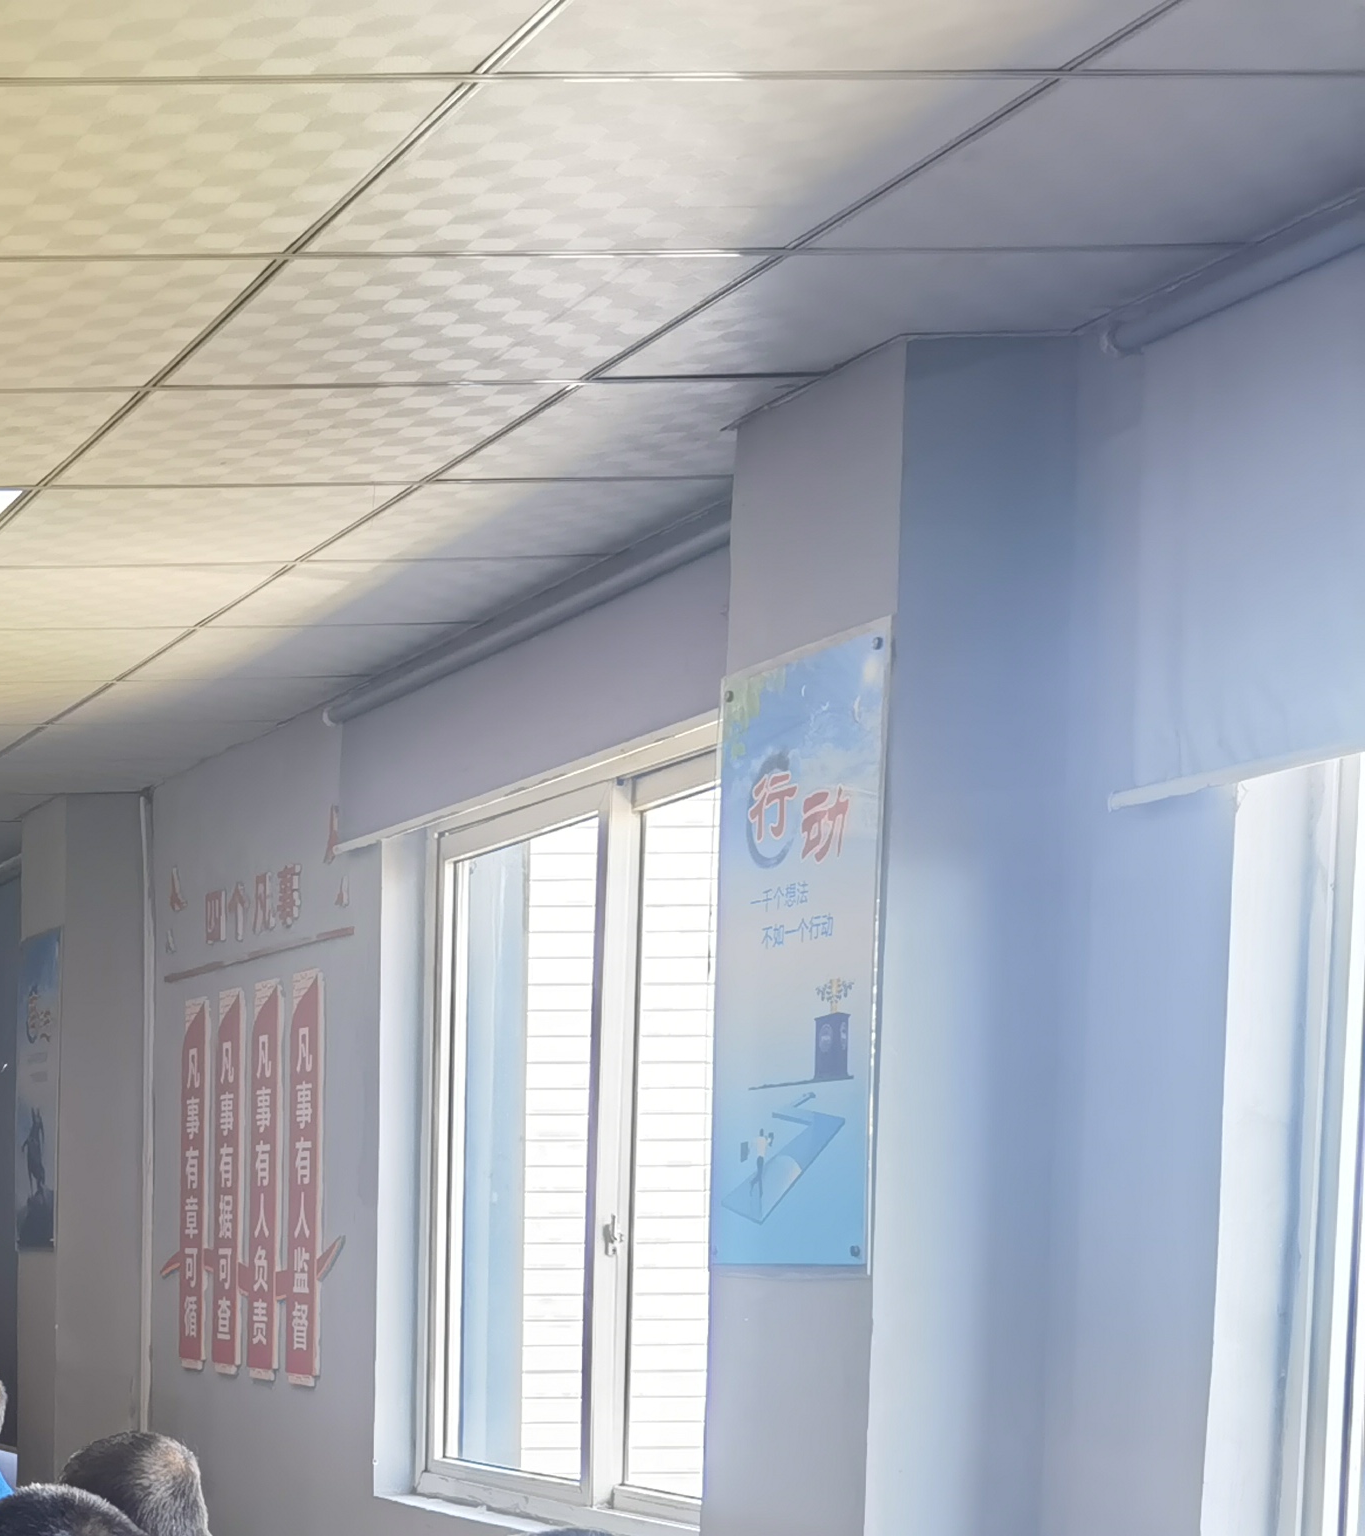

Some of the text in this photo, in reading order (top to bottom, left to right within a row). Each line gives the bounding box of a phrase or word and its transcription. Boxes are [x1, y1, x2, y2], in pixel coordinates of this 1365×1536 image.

[748, 772, 850, 864] 行动
[750, 881, 809, 907] 一千个想法
[761, 913, 835, 949] 不如一个行动
[183, 1046, 201, 1340] 凡事有章可循
[216, 1039, 236, 1343] 凡事有据可查
[251, 1032, 272, 1347] 凡事有人负责
[290, 1026, 314, 1353] 凡事有人监督
